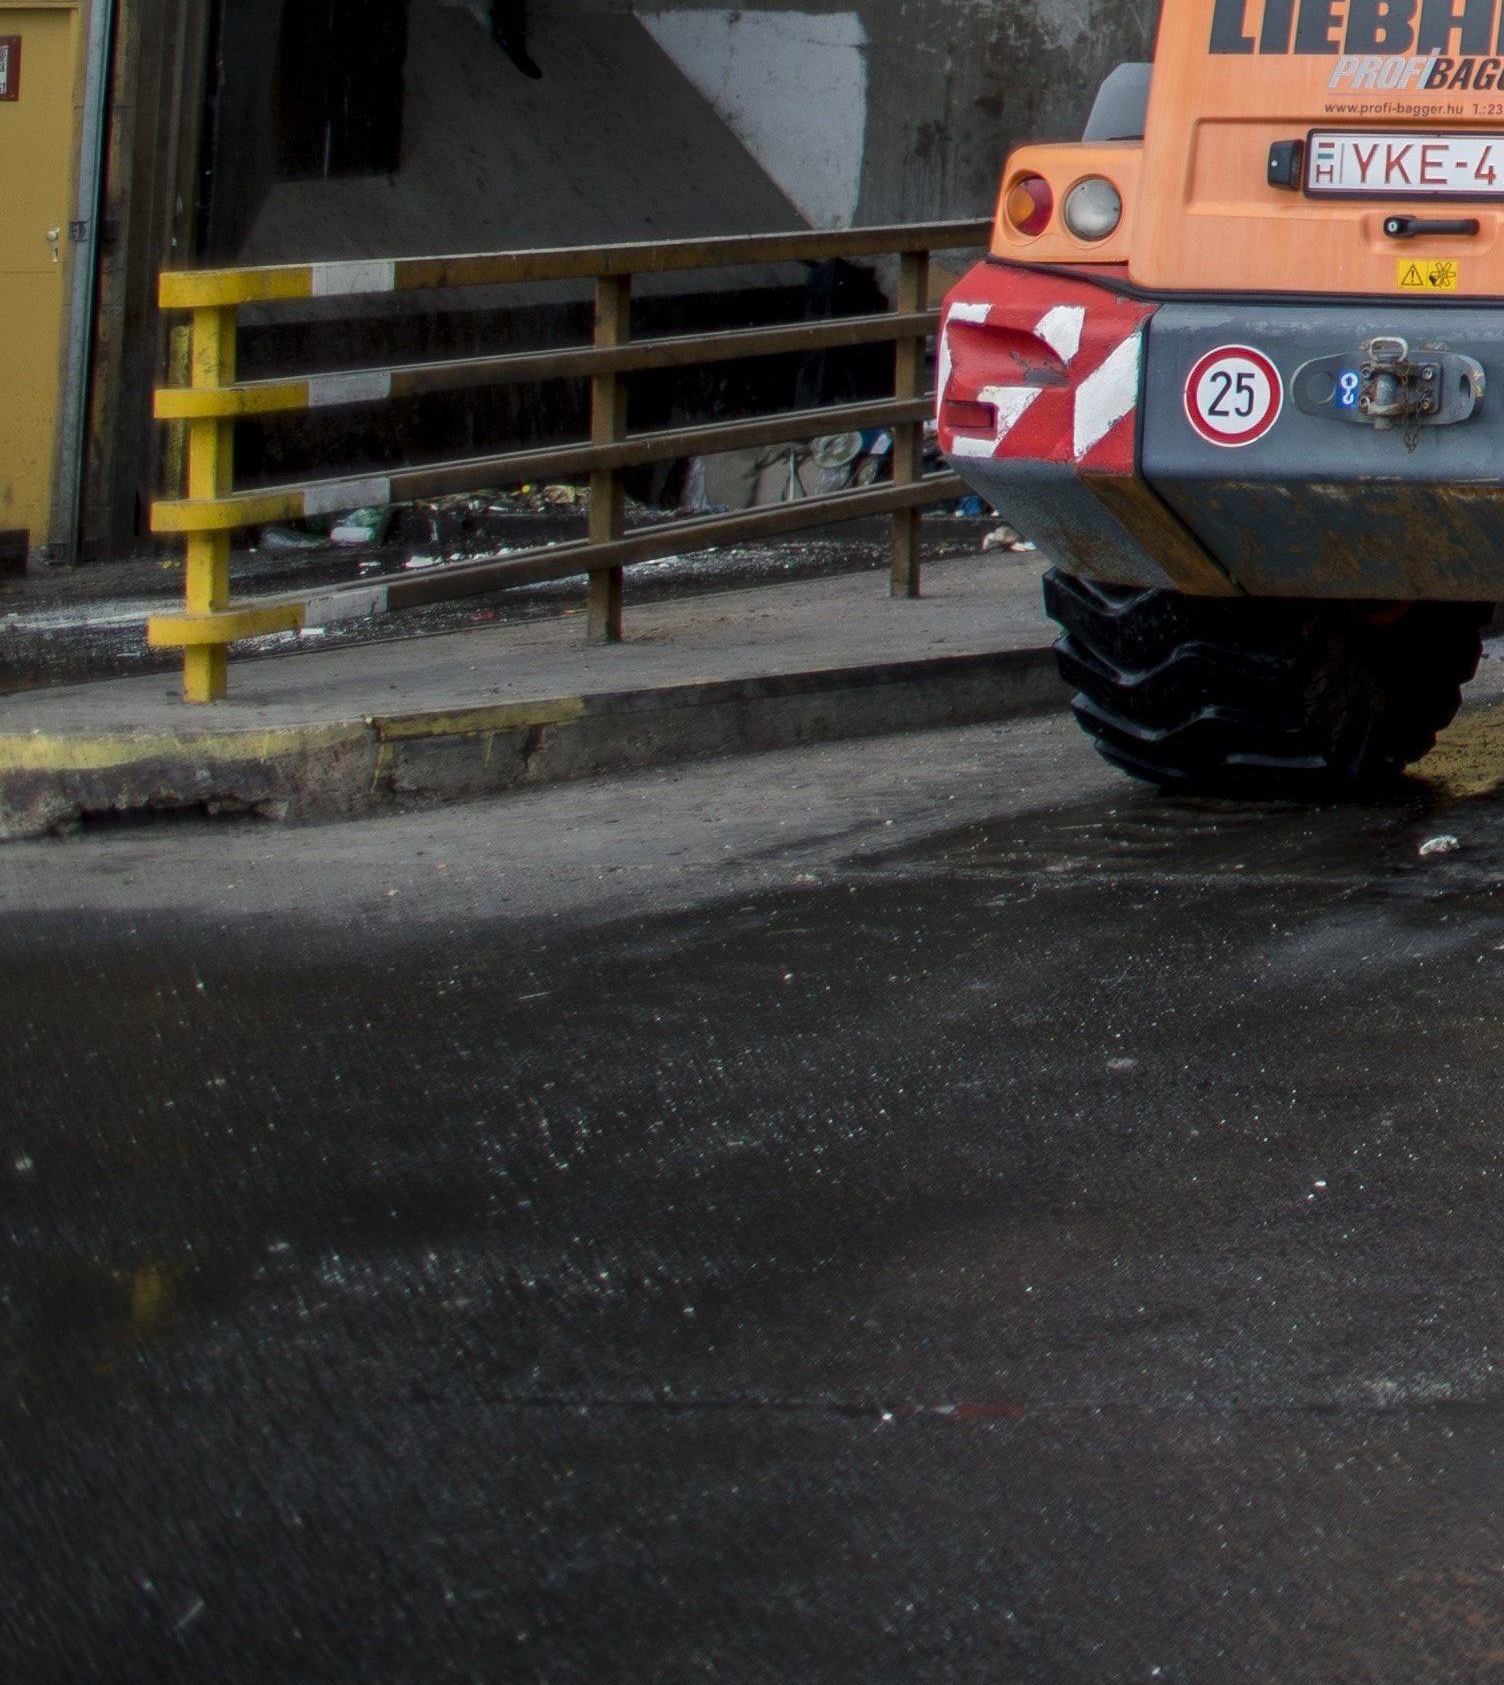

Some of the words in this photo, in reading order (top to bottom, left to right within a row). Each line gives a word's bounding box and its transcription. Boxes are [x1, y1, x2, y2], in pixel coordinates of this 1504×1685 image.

[1325, 102, 1464, 117] www.profi-bagger.hu
[1315, 160, 1333, 183] H
[1207, 371, 1255, 417] 25
